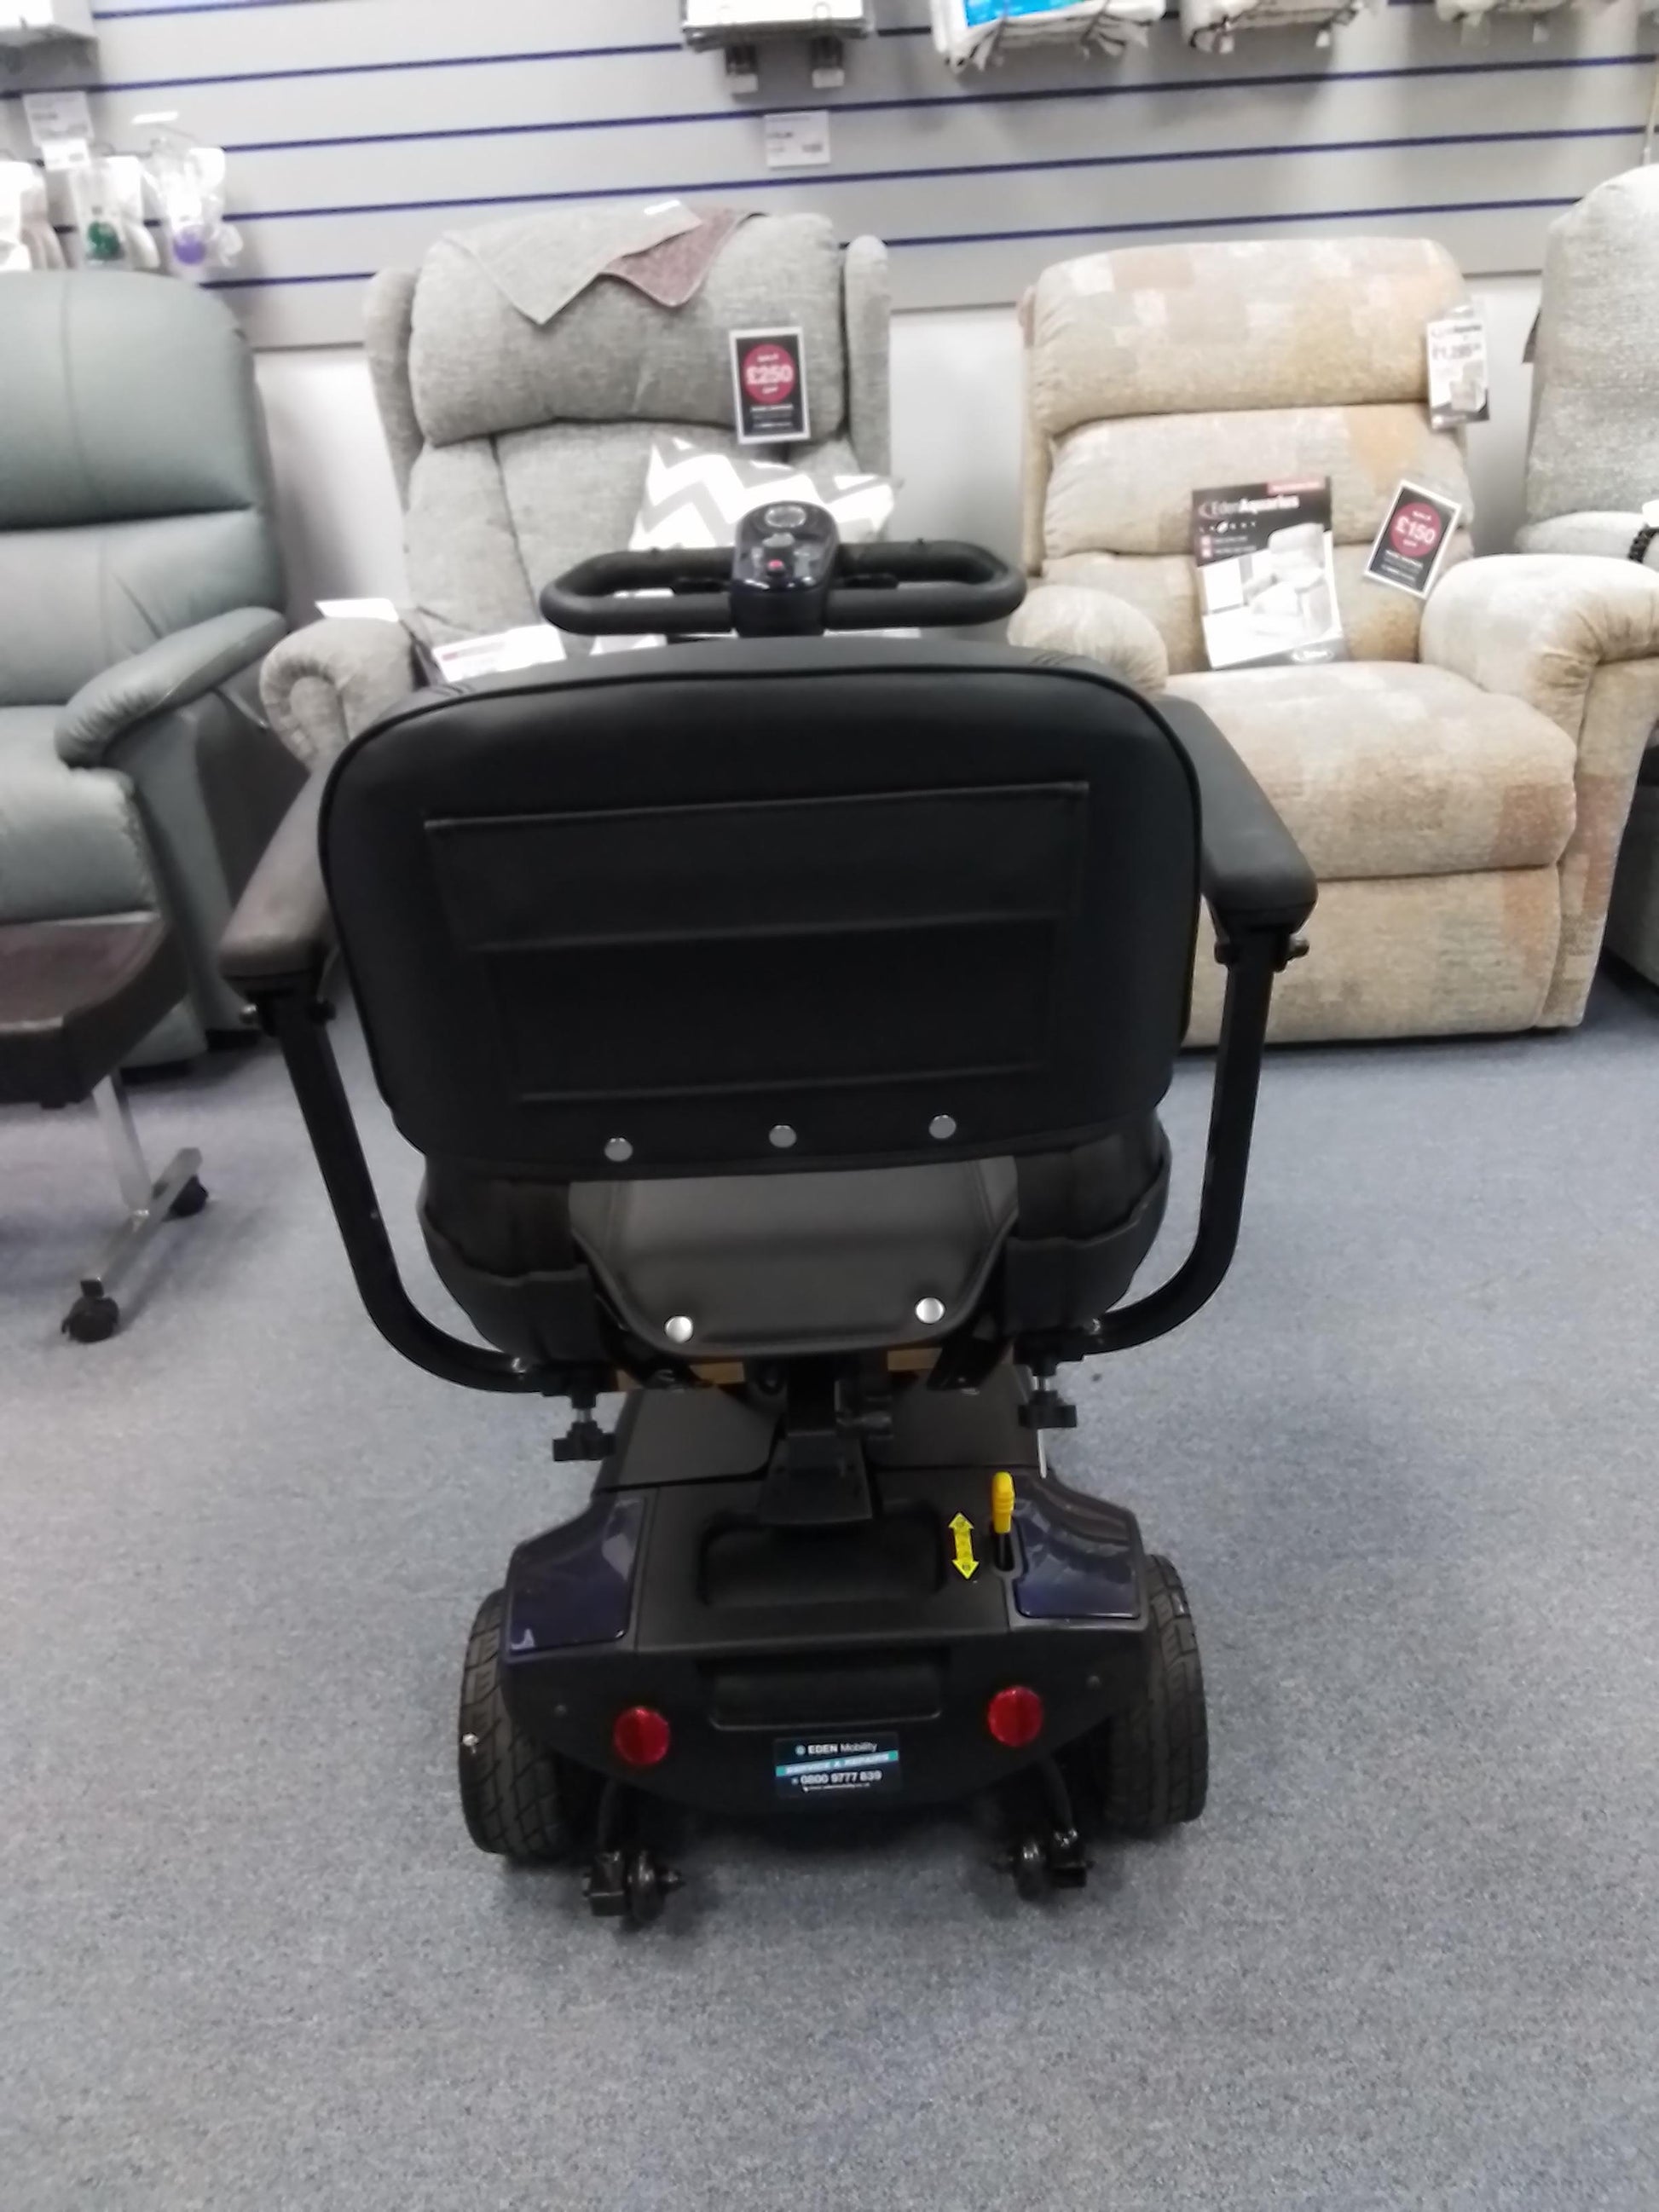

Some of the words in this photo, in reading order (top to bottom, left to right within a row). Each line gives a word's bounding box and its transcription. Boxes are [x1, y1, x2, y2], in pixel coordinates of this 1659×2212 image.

[1396, 516, 1436, 545] £150
[807, 1743, 838, 1754] EDEN
[840, 1741, 877, 1753] Mobility
[800, 1773, 829, 1785] 0800
[830, 1772, 858, 1782] 9777
